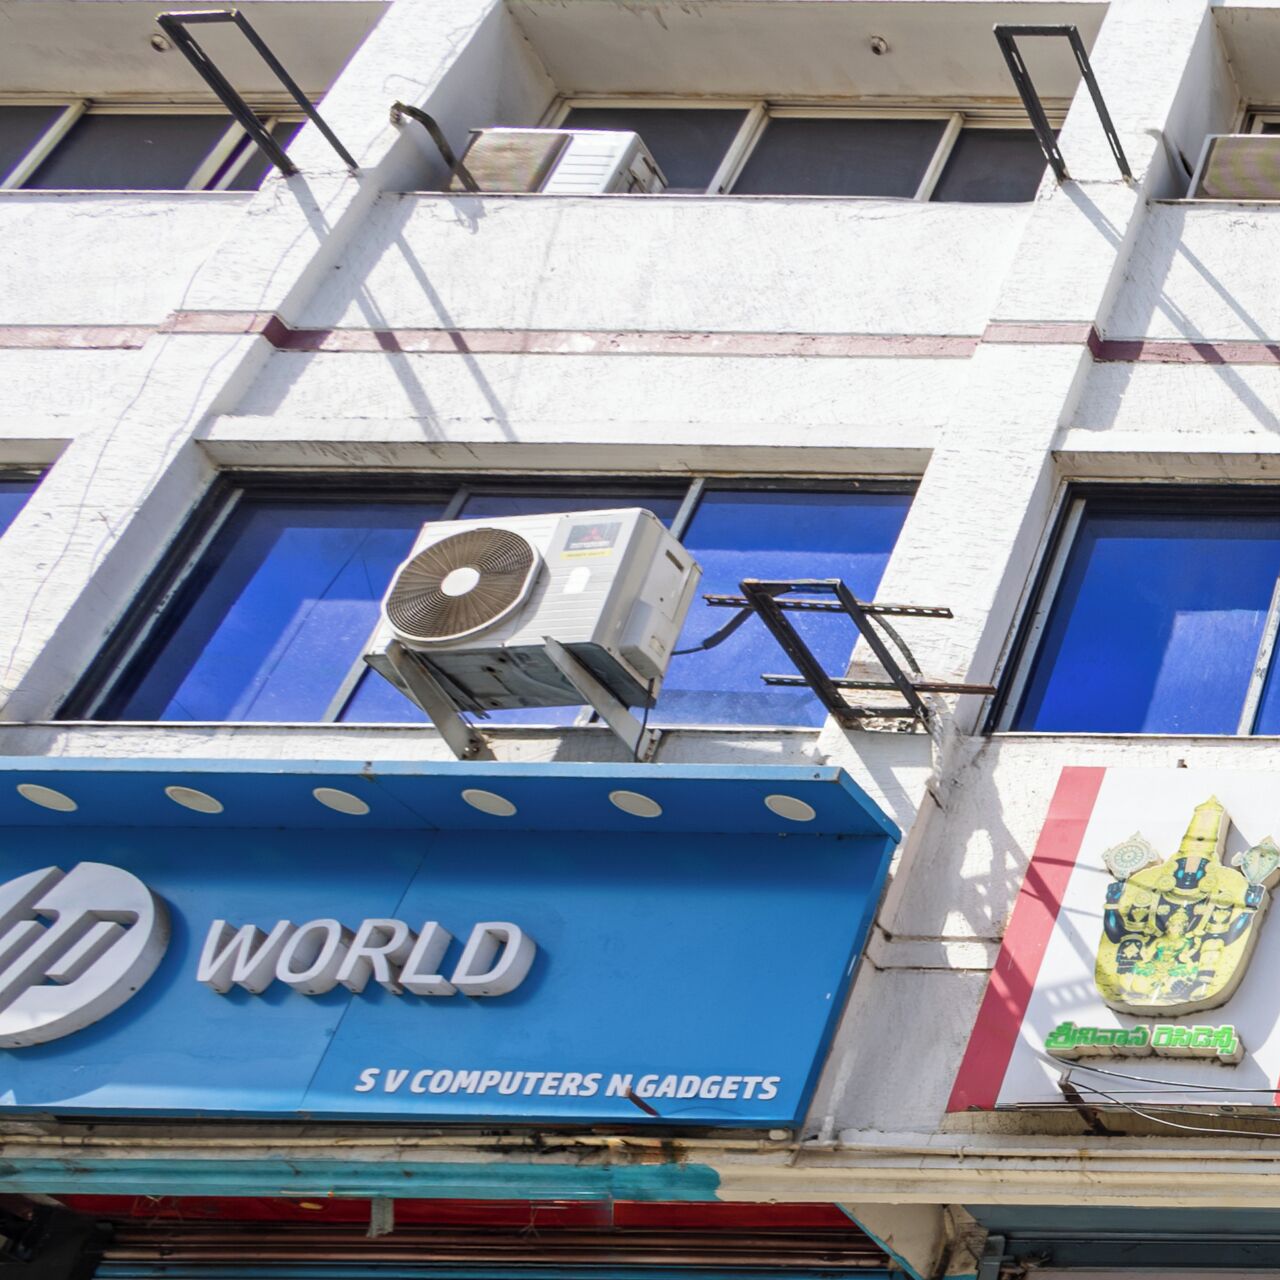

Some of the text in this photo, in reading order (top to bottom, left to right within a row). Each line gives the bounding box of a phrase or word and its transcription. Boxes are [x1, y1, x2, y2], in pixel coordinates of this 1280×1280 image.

[197, 918, 535, 997] WORLD
[355, 1067, 781, 1101] S V COMPUTERS N GADGETS
